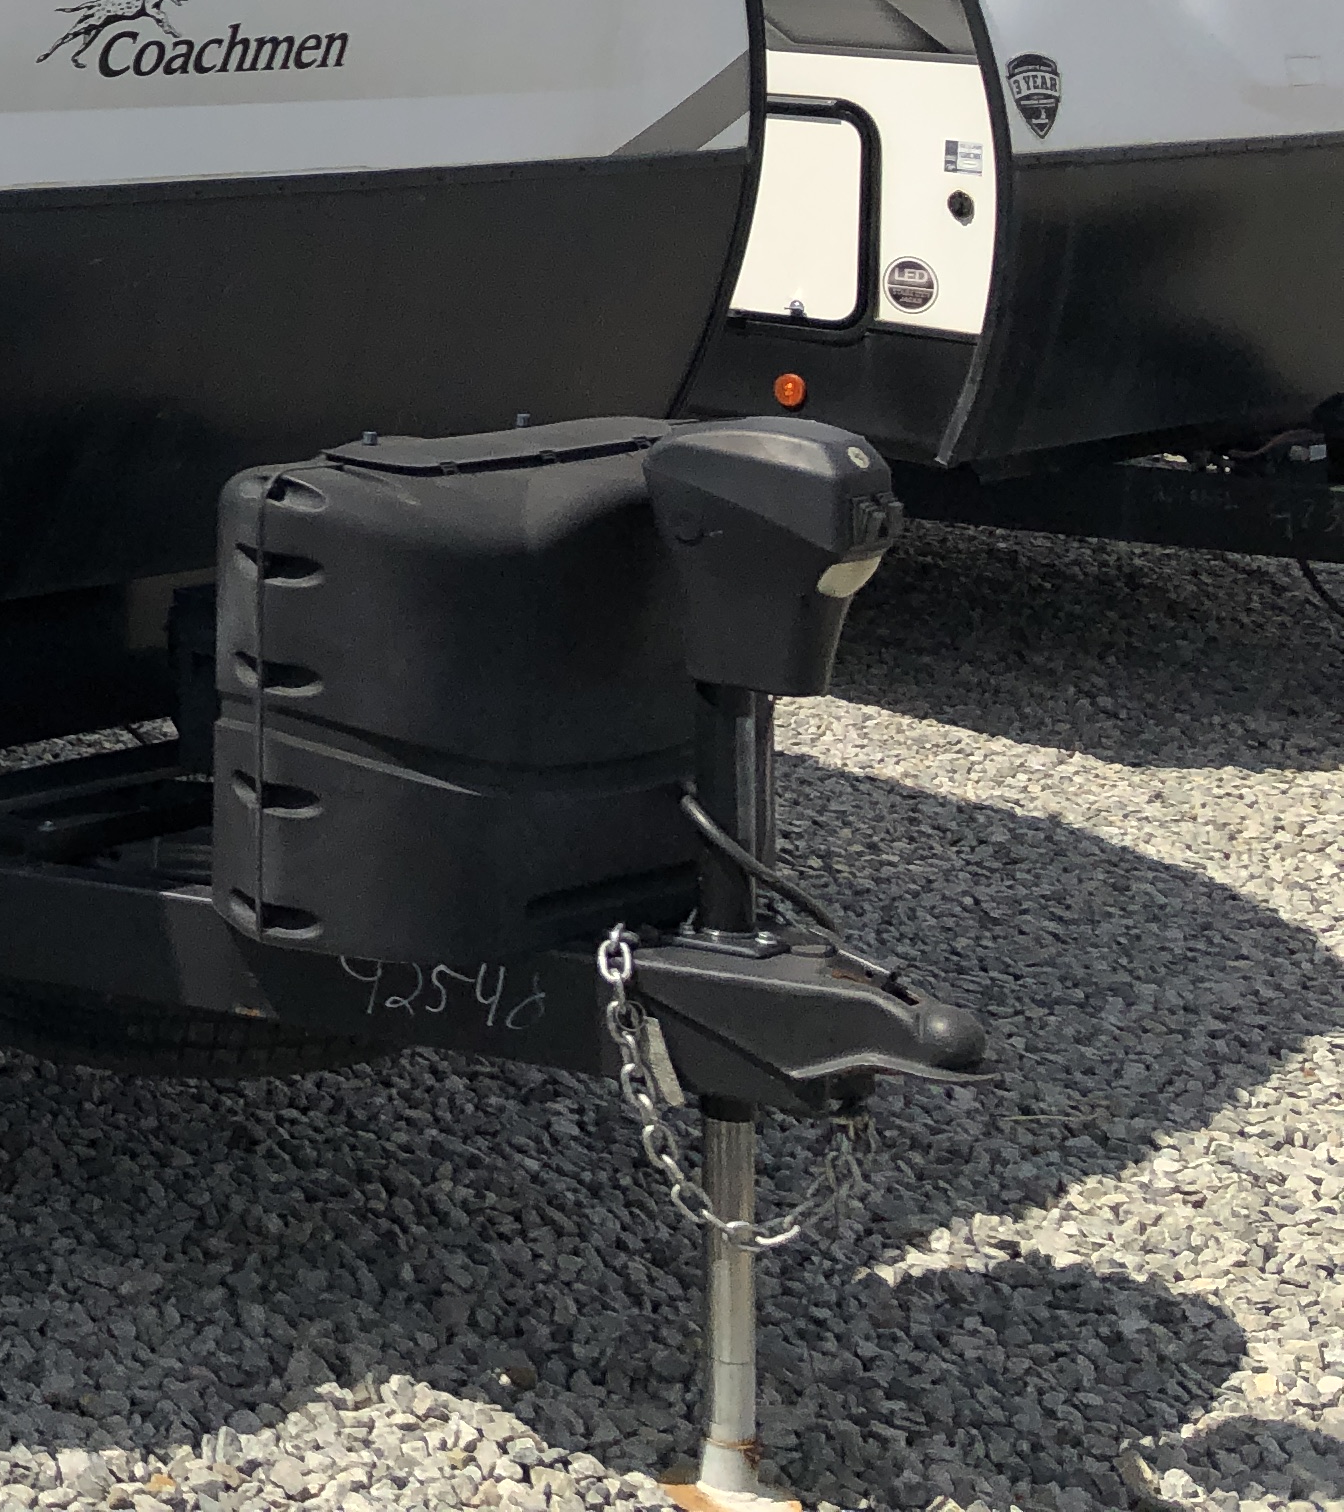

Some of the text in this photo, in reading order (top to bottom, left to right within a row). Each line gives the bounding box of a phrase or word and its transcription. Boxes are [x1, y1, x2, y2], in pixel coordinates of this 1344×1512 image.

[97, 22, 350, 78] Coachmen
[1012, 74, 1058, 95] 3 YEAR
[894, 267, 929, 283] LED
